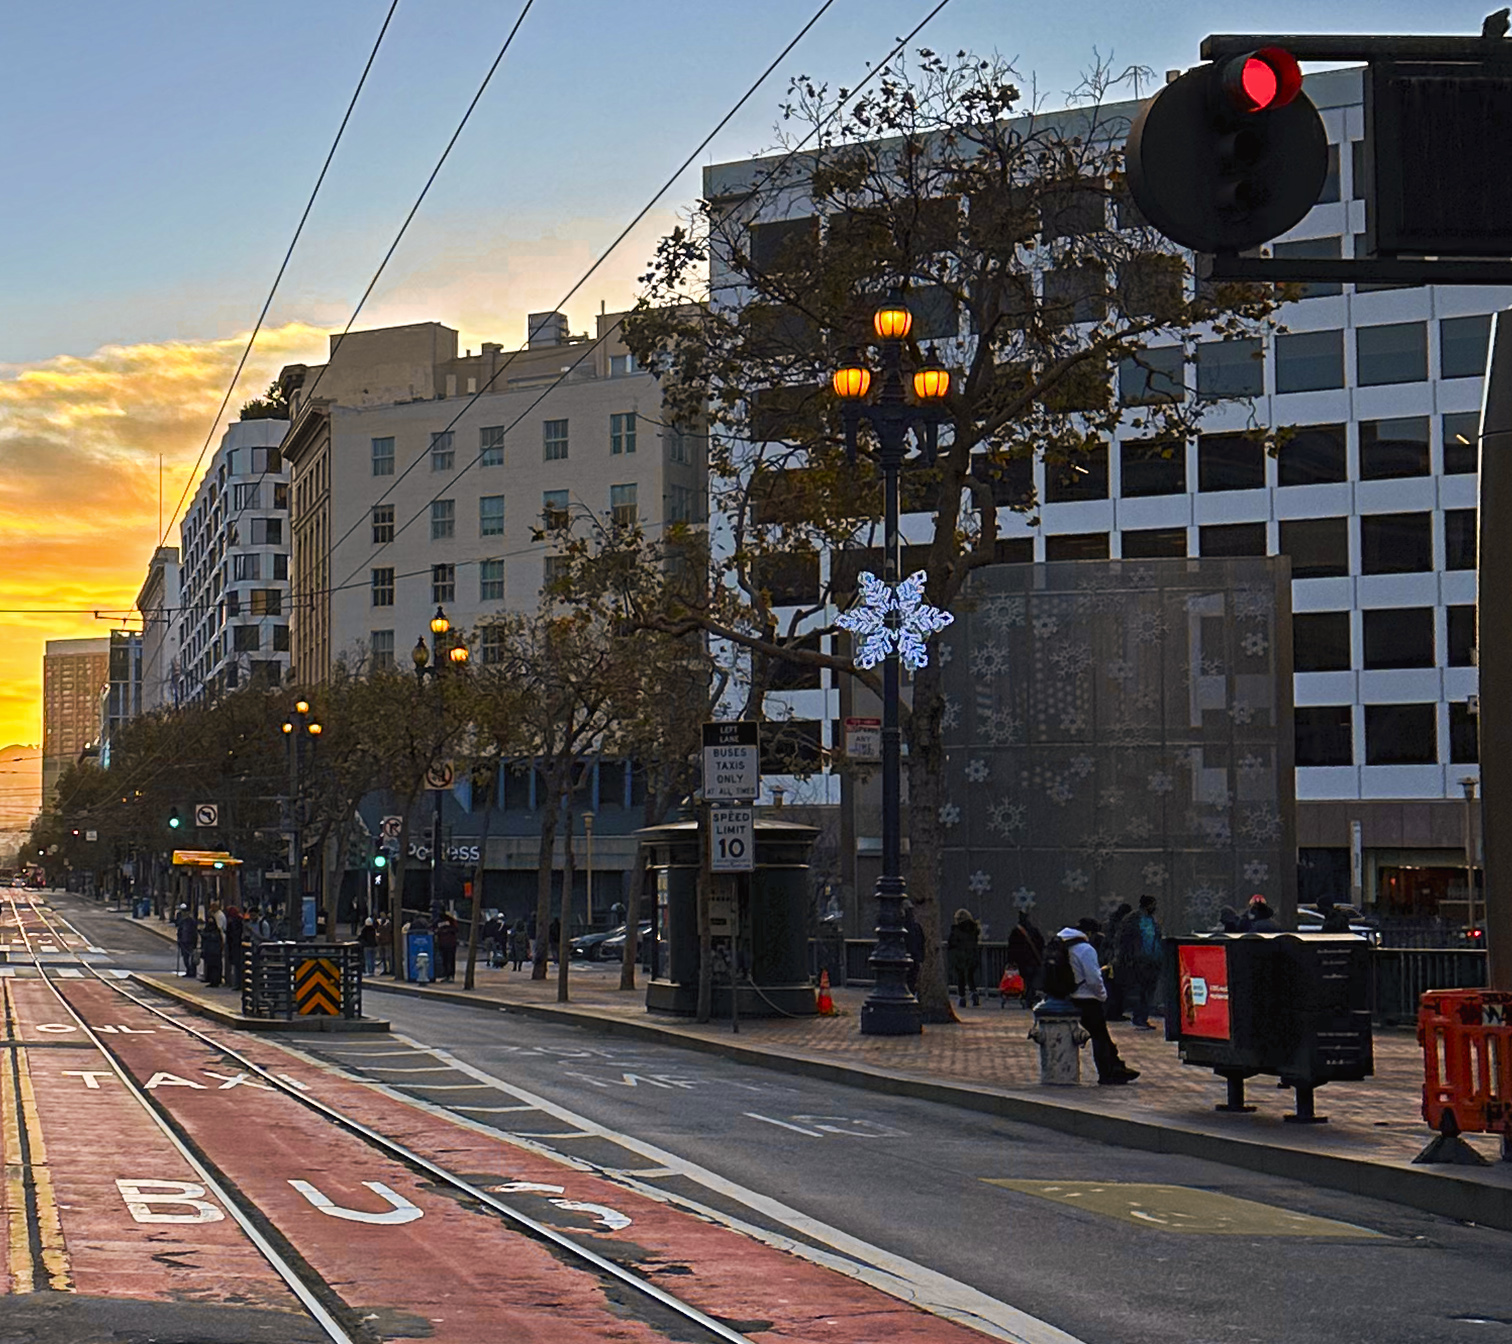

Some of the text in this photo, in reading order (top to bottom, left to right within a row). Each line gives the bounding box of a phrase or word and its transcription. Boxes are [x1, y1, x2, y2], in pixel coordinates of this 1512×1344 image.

[719, 725, 739, 734] LEFT
[719, 735, 740, 744] LANE
[713, 747, 748, 758] BUSES
[716, 761, 746, 770] TAXIS
[716, 774, 744, 784] ONLY
[713, 812, 750, 822] SPEED
[716, 825, 745, 835] LIMIT
[718, 838, 745, 859] 10
[35, 1023, 196, 1034] ONLY
[61, 1070, 312, 1091] TAXI
[115, 1178, 633, 1233] BUS
